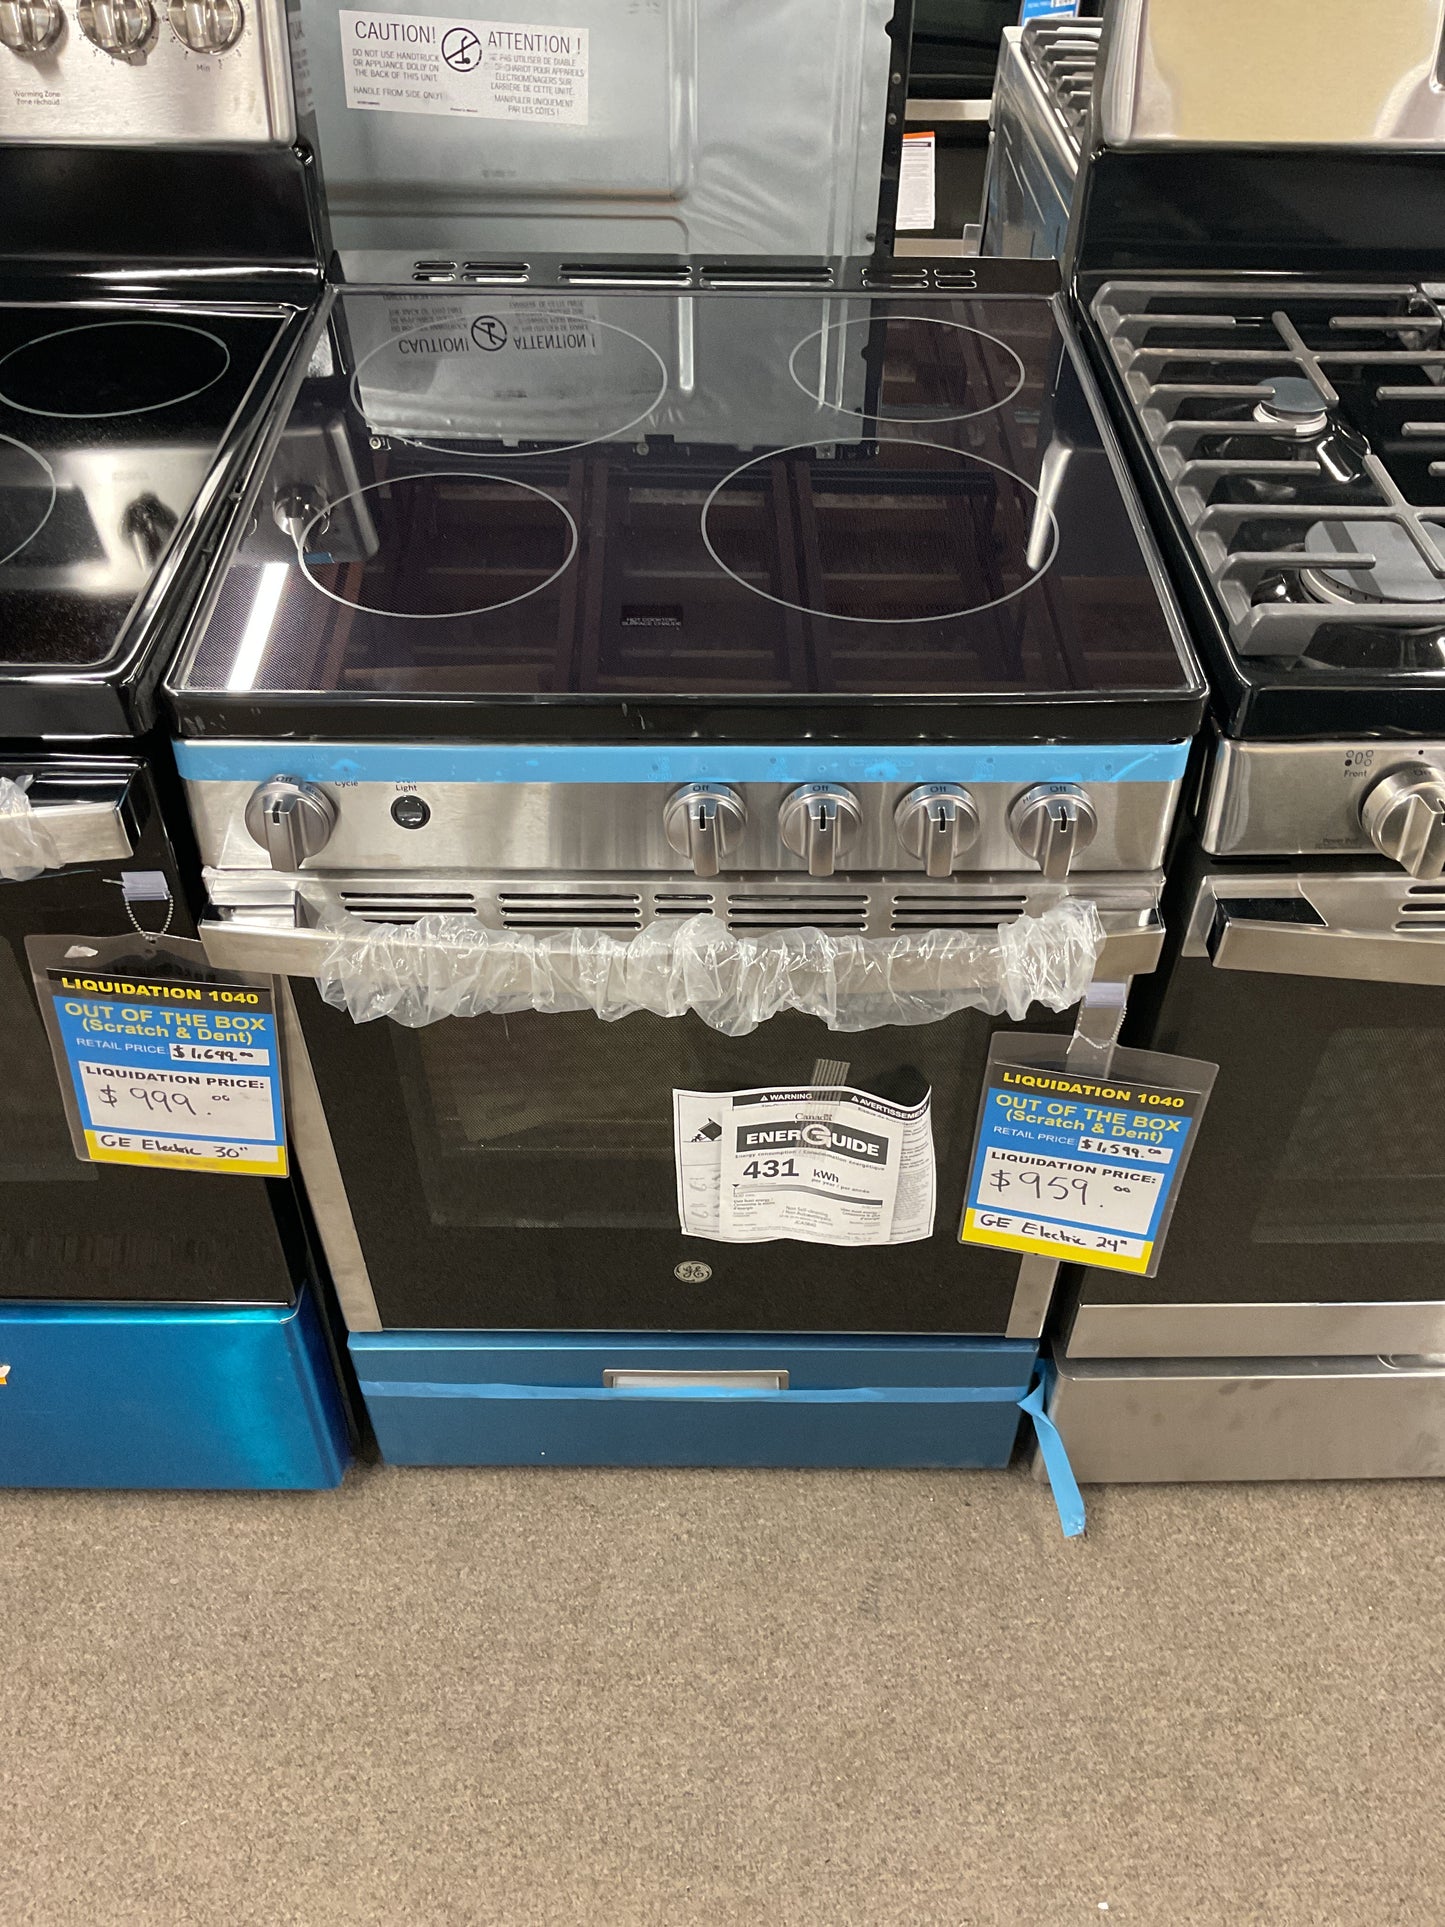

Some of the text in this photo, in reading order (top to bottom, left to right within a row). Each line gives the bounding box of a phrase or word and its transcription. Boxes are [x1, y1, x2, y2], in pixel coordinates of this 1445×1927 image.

[355, 21, 436, 44] CAUTION!
[488, 31, 570, 54] ATTENTION
[352, 48, 440, 62] DO NOT USE HANDTRUCK
[514, 55, 541, 64] UTILISER
[544, 57, 552, 66] DE
[554, 58, 576, 66] DIABLE
[196, 64, 211, 73] Min
[353, 59, 439, 72] OR APPLIANCE DOLLY ON
[533, 66, 550, 74] POUR
[355, 68, 368, 77] THE
[370, 70, 389, 78] BACK
[403, 72, 419, 80] THIS
[354, 86, 380, 95] HANDLE
[383, 88, 403, 97] FROM
[406, 90, 421, 98] SIDE
[523, 84, 532, 92] DE
[1343, 769, 1368, 778] Front
[395, 784, 418, 792] Light
[692, 784, 709, 792] Off
[812, 784, 829, 792] Off
[61, 978, 259, 1004] LIQUIDATION 1040
[65, 1002, 266, 1031] OUT OF THE BOX
[82, 1018, 254, 1046] (Scratch & Dent)
[76, 1038, 122, 1051] RETAIL
[86, 1066, 265, 1090] LIQUIDATION PRICE:
[770, 1092, 813, 1101] WARNING
[1002, 1072, 1184, 1108] LIQUIDATION 1040
[858, 1097, 928, 1121] AVERTISSEMENT
[995, 1094, 1182, 1133] OUT OF THE BOX
[993, 1125, 1035, 1140] RETAIL
[1006, 1108, 1164, 1144] (Scratch & Dent)
[100, 1134, 130, 1148] GE
[142, 1138, 202, 1156] Electric
[743, 1158, 800, 1178] 431
[991, 1151, 1156, 1184] LIQUIDATION PRICE:
[813, 1169, 840, 1184] kWh
[980, 1213, 1013, 1228] GE
[1021, 1222, 1088, 1246] Electric
